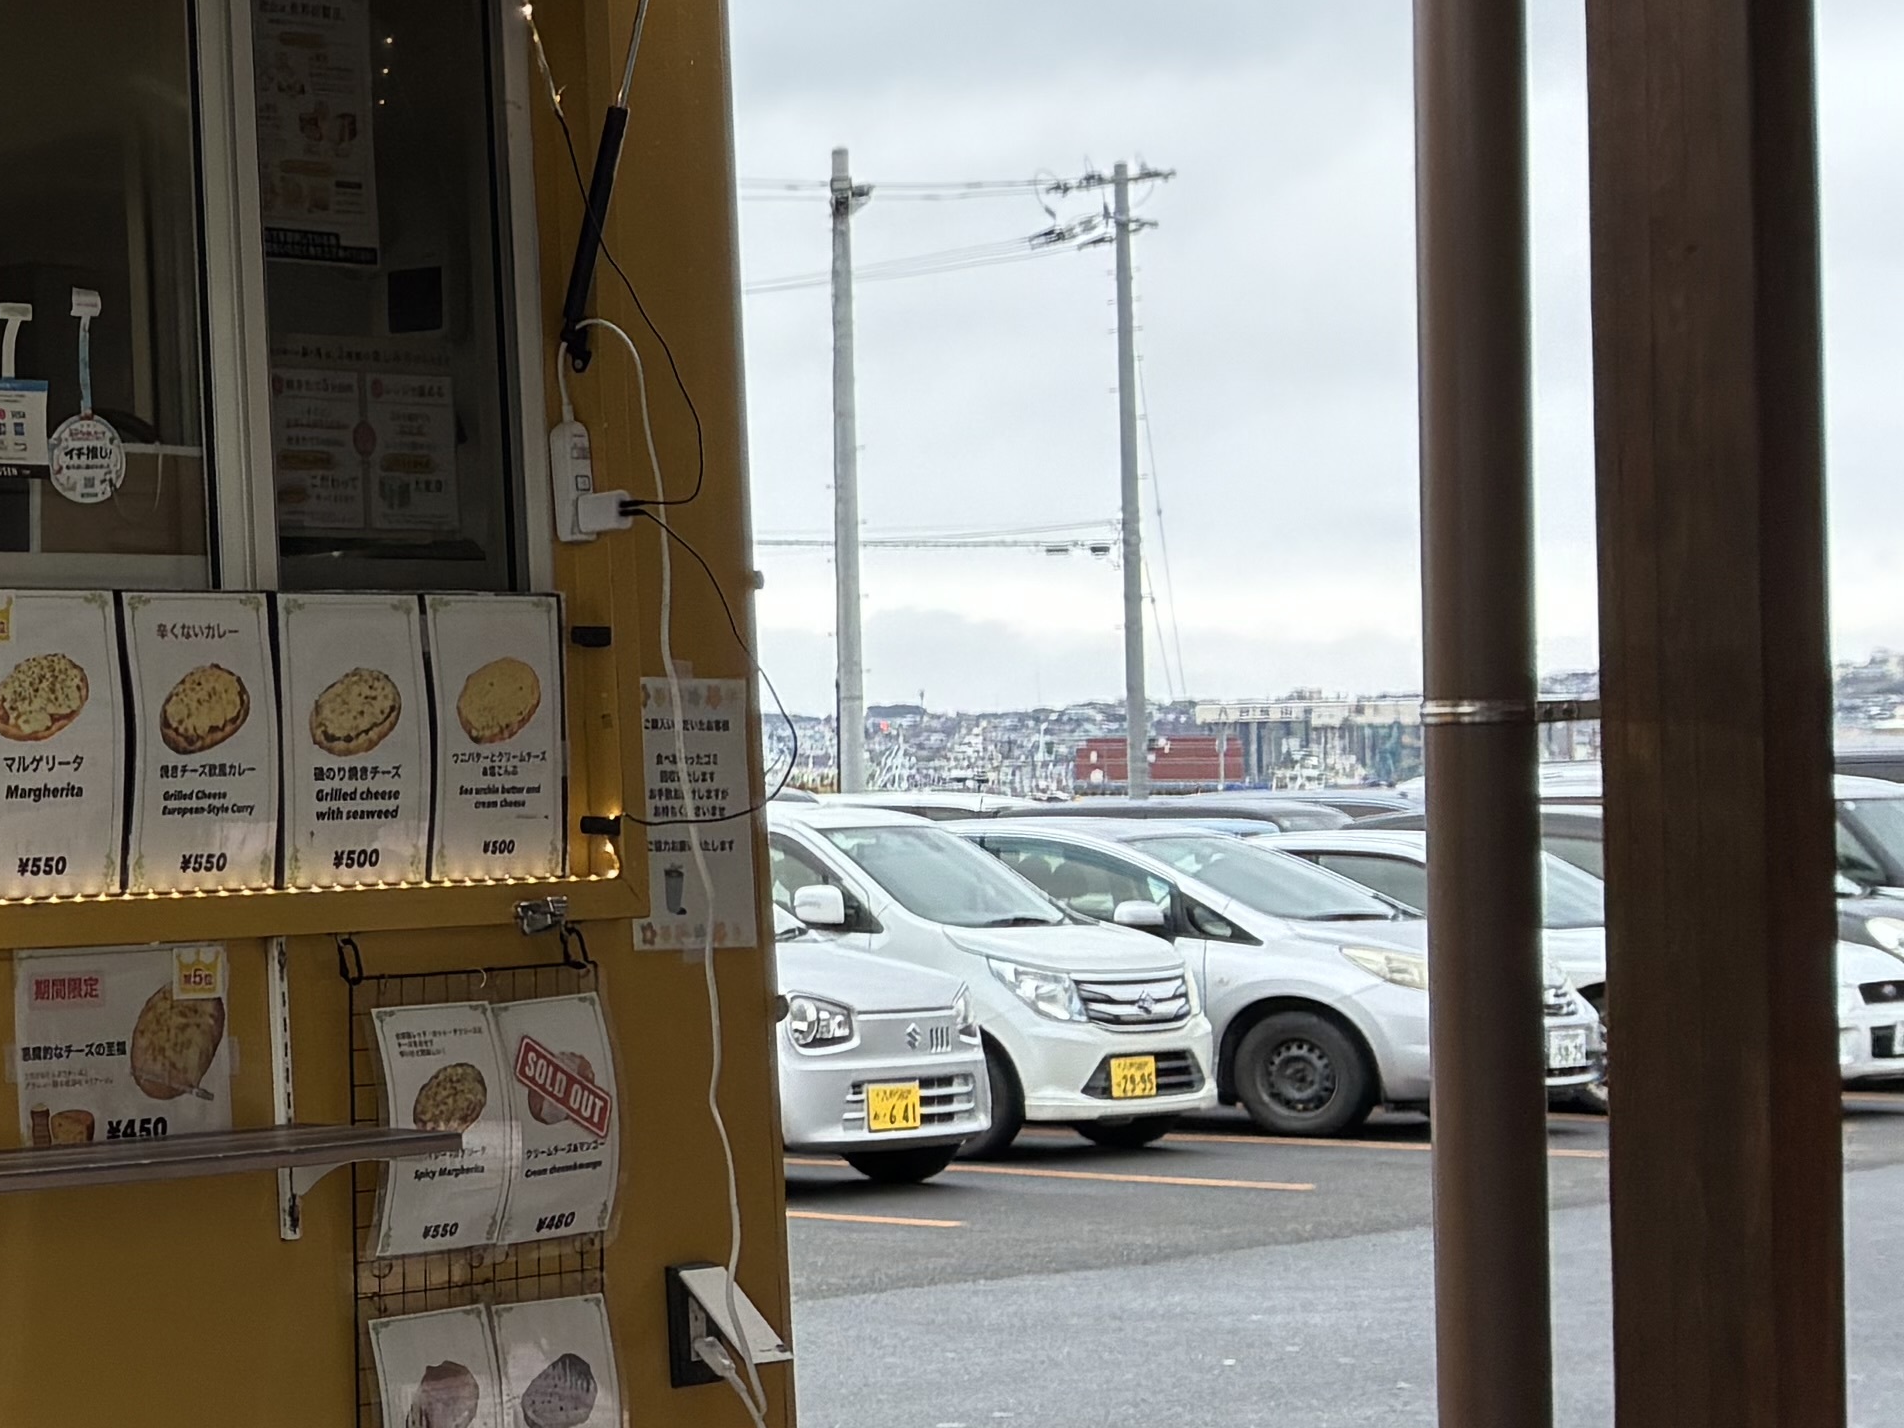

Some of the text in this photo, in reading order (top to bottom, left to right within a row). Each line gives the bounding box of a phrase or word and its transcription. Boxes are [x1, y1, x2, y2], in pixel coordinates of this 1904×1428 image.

[156, 622, 240, 640] 辛くないカレー
[3, 755, 84, 772] マルゲリータ
[5, 781, 84, 803] Margherita
[315, 786, 400, 802] Grilled cheese
[231, 802, 255, 816] Curry
[315, 804, 399, 821] with seaweed
[17, 856, 67, 876] ¥550
[180, 852, 228, 873] ¥550
[333, 848, 380, 869] ¥500
[34, 976, 100, 1001] 期間限定
[524, 1050, 606, 1128] SOLD OUT
[106, 1117, 168, 1140] ¥450
